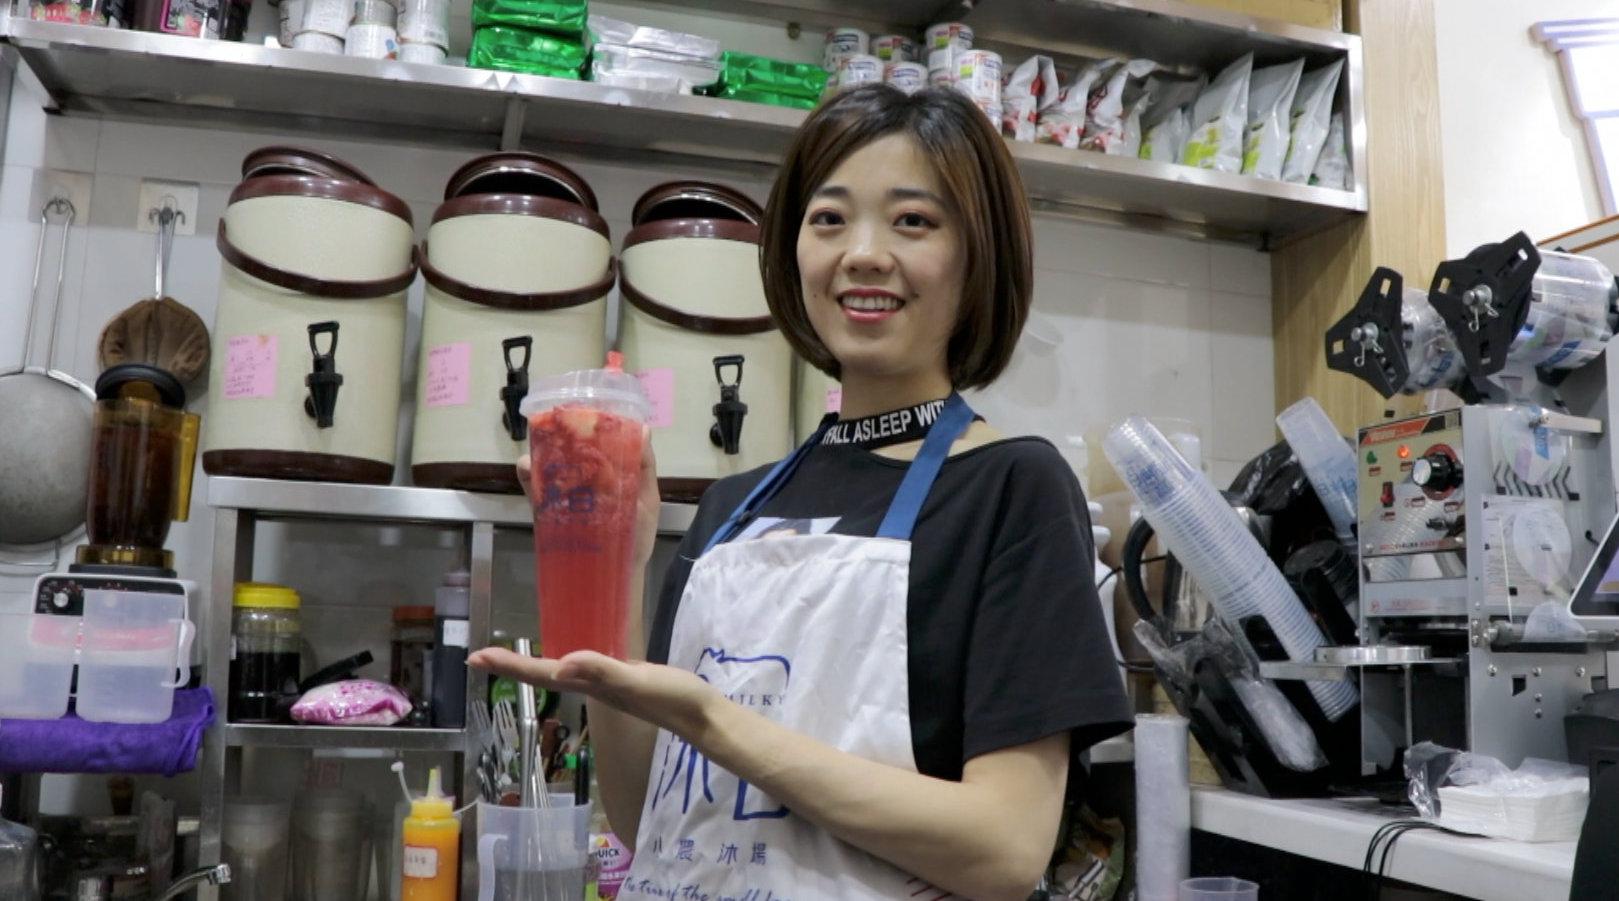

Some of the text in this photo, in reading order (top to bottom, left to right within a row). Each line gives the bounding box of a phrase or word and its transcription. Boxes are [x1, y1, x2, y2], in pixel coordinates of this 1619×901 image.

[853, 410, 912, 443] ASLEEP
[914, 399, 945, 428] WIT
[593, 848, 620, 858] UICK
